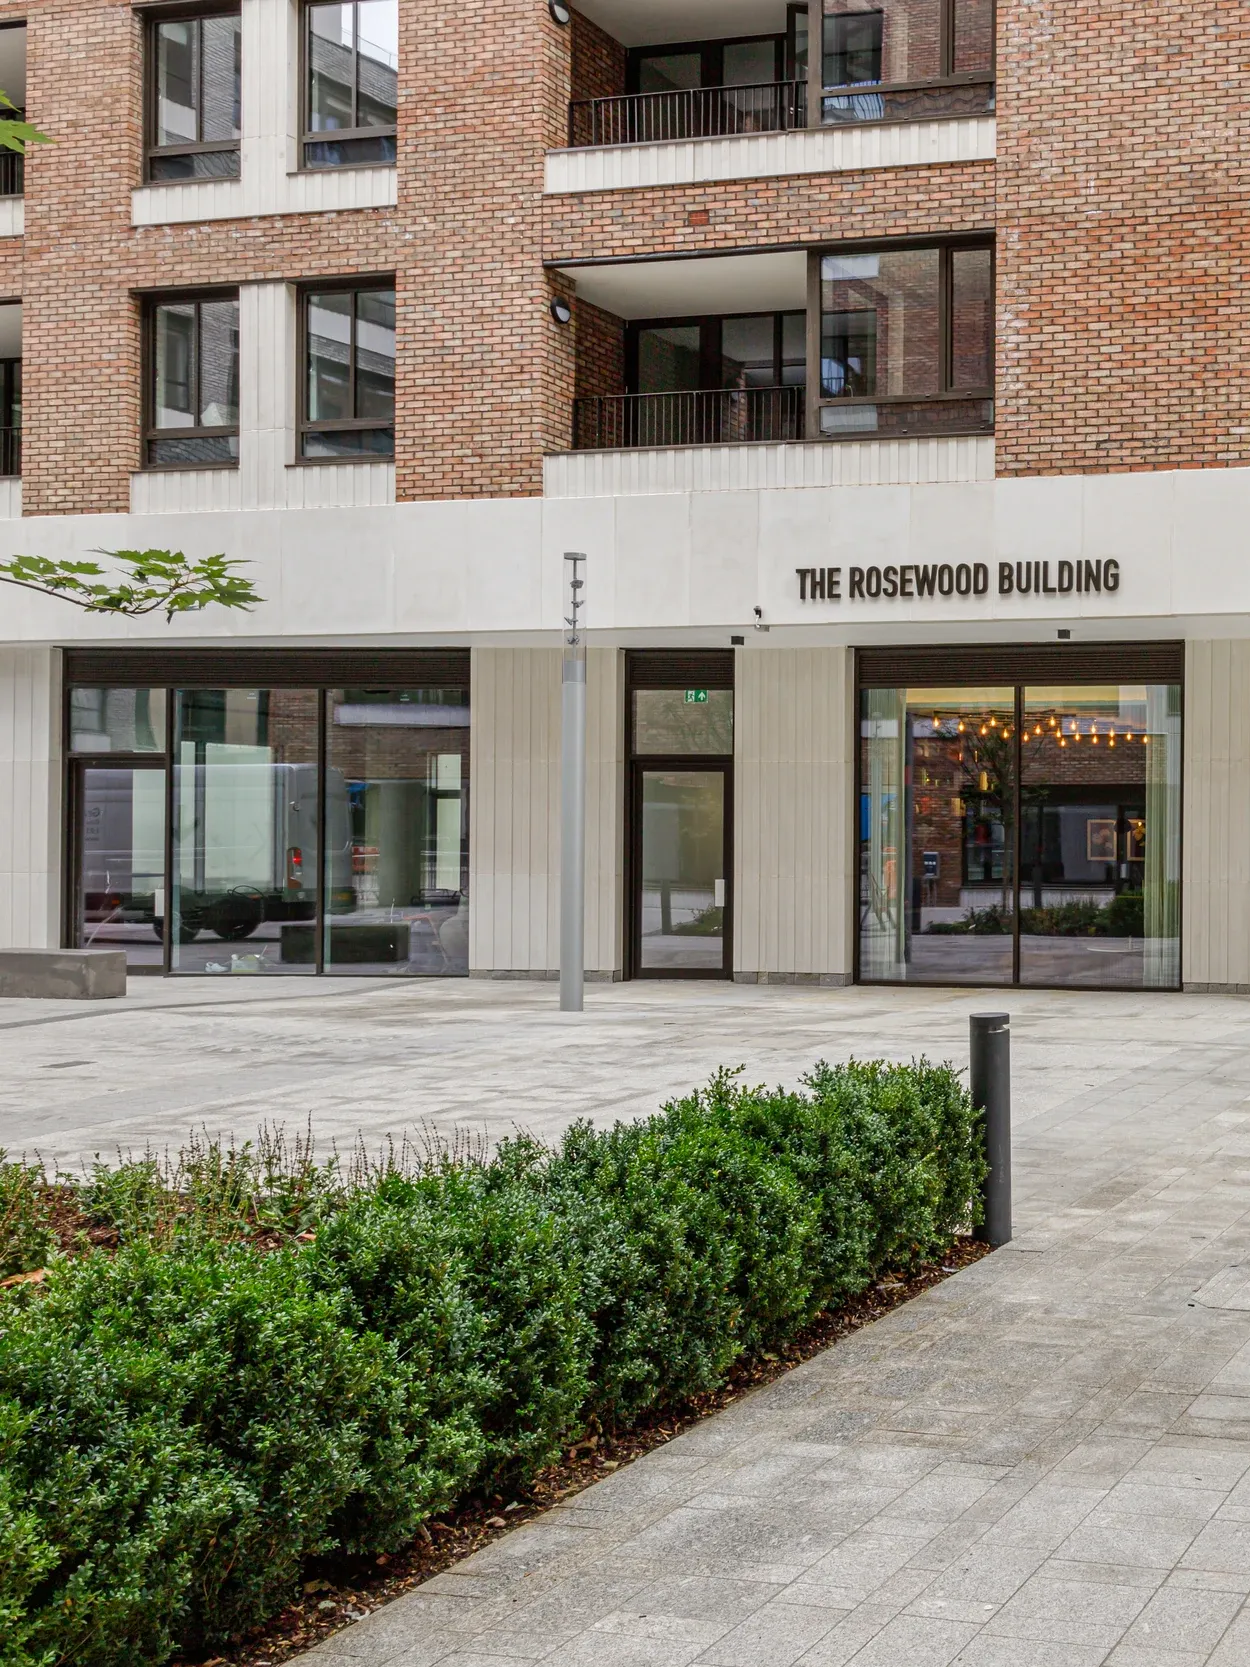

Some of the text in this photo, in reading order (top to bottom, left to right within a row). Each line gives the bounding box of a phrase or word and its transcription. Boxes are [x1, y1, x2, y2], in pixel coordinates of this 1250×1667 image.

[795, 558, 1120, 600] THE ROSEWOOD BUILDING
